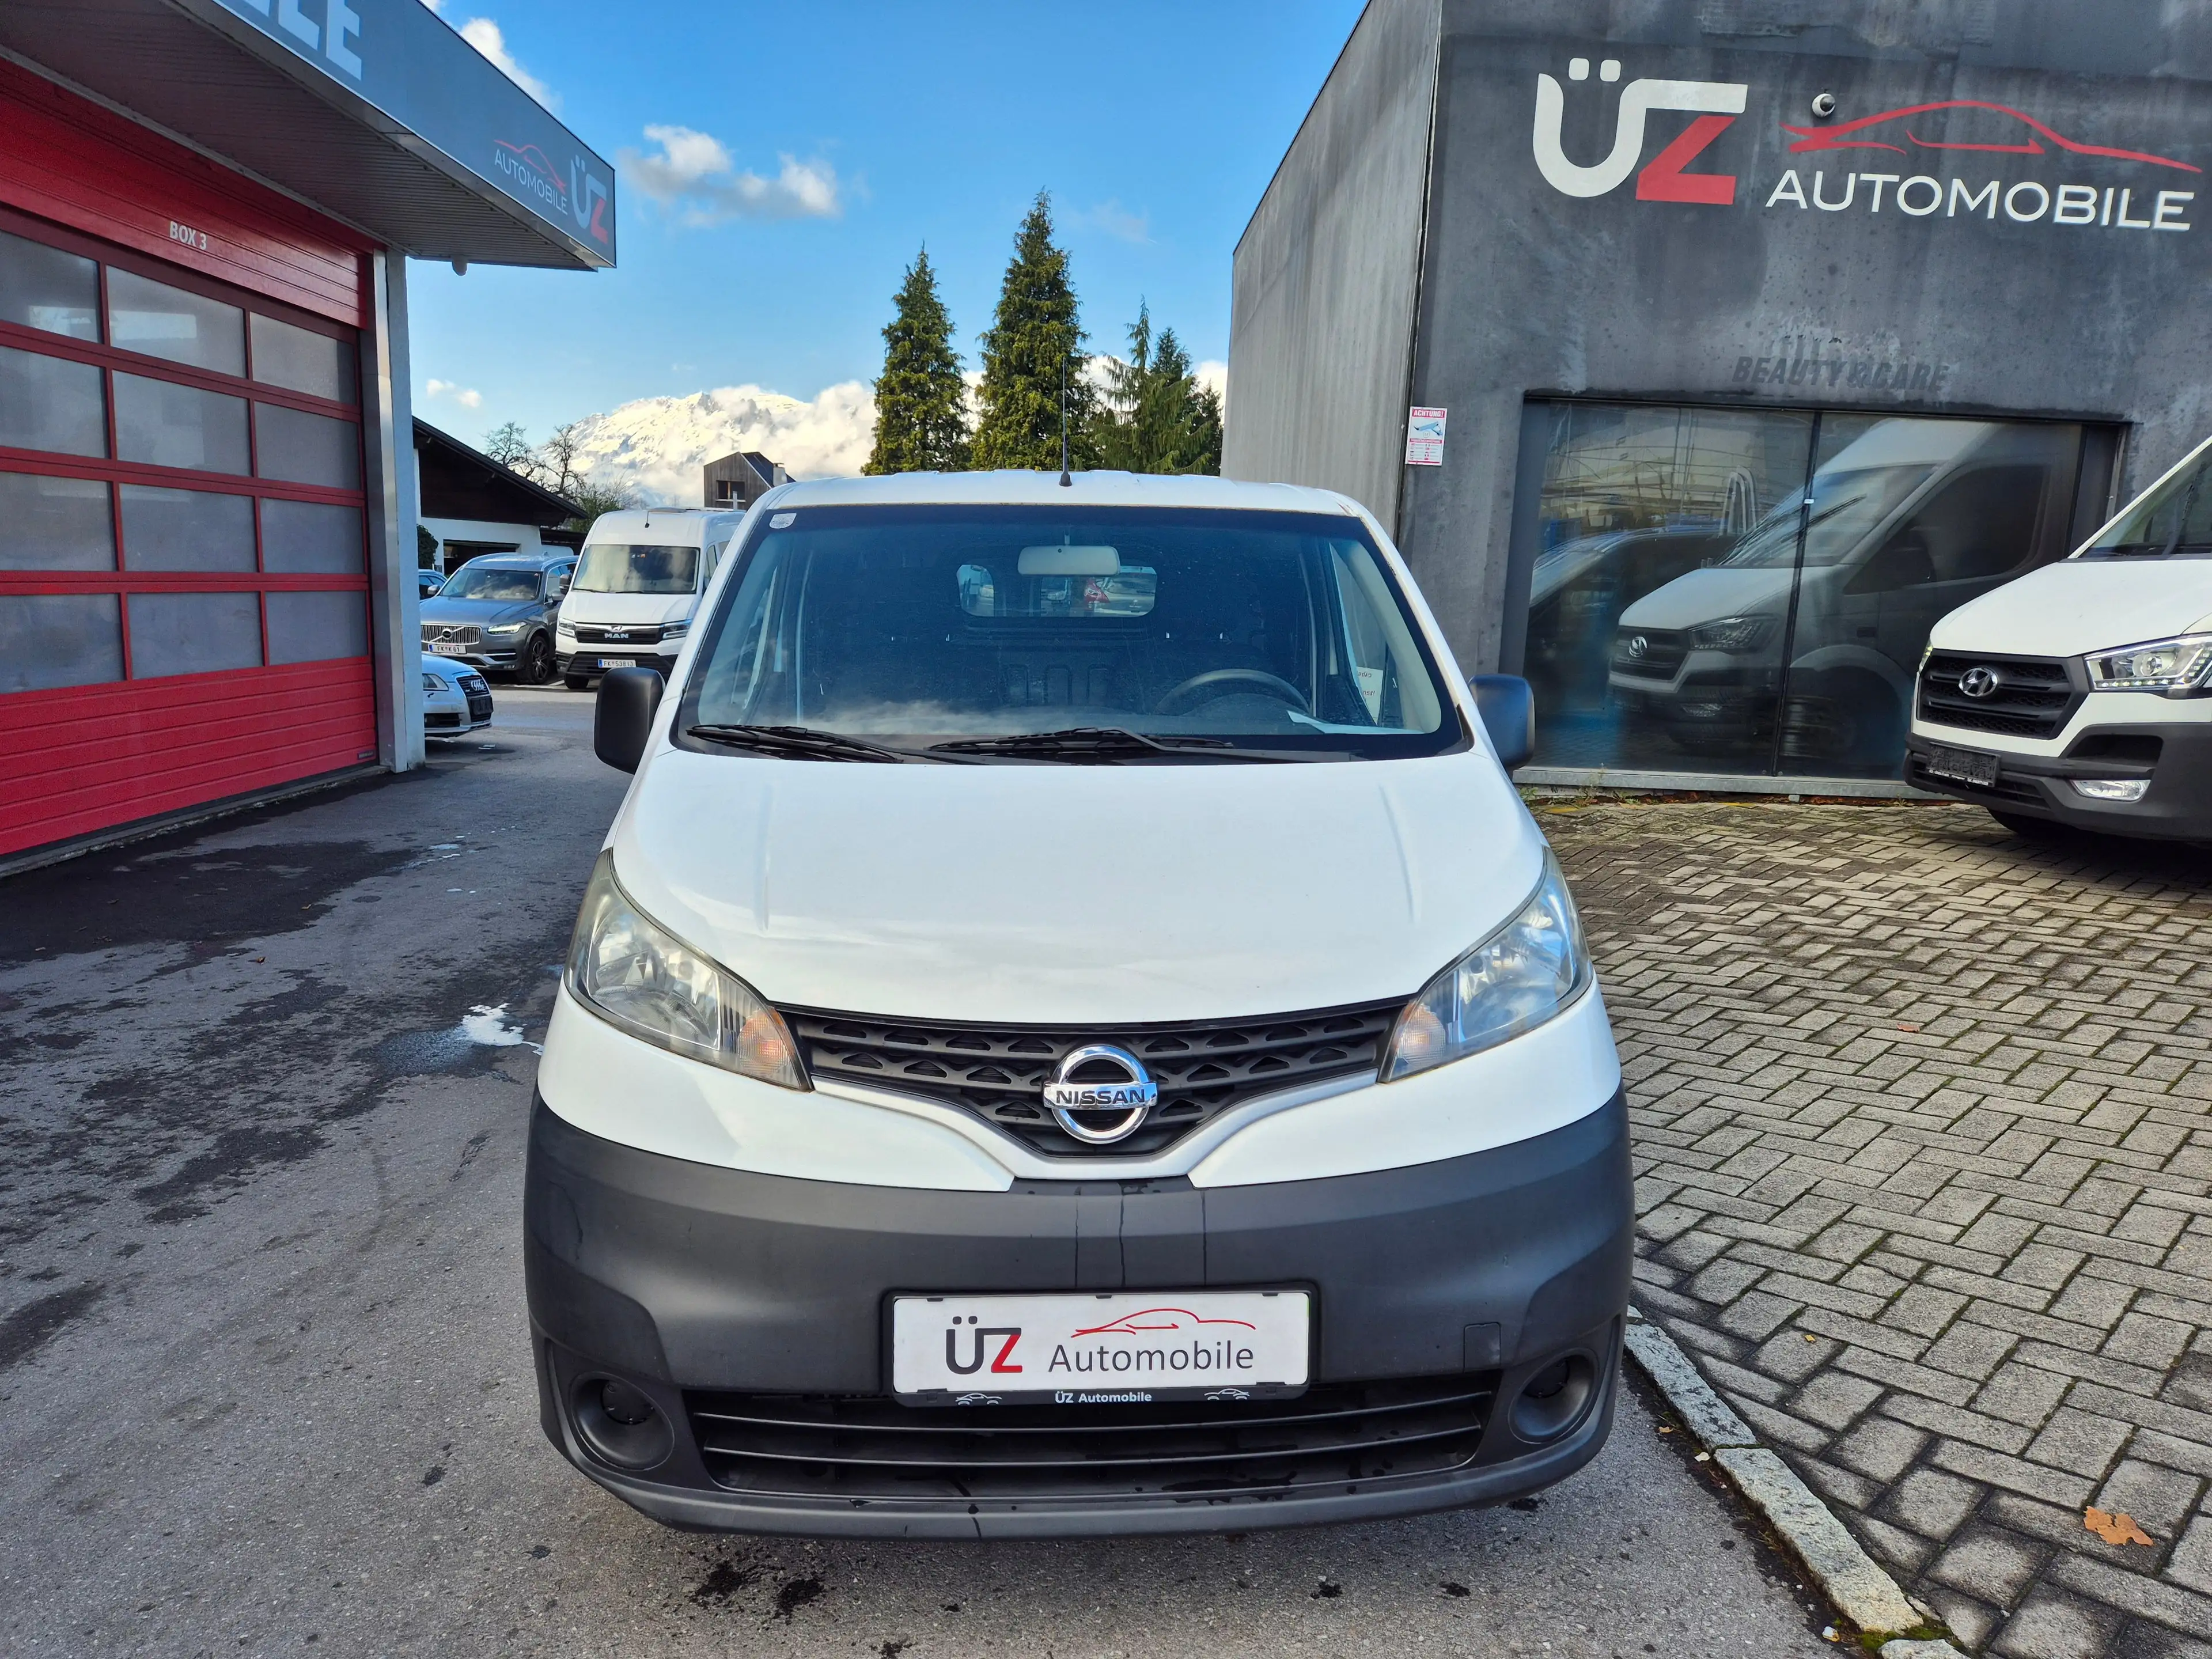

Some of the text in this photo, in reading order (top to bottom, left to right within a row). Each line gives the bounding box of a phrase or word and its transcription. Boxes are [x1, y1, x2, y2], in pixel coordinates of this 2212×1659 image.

[1533, 58, 1748, 204] ÜZ
[494, 148, 609, 244] AUTOMOBILE ÜZ
[1766, 169, 2194, 231] AUTOMOBILE
[170, 221, 207, 250] BOX 3
[1732, 356, 1847, 387] BEAUTY
[1872, 362, 1949, 392] CARE
[1414, 410, 1444, 418] ACHTUNG!
[1056, 1089, 1145, 1104] NISSAN
[946, 1316, 1254, 1374] ÜZ Automobile
[1055, 1391, 1152, 1403] ÜZ Automobile
